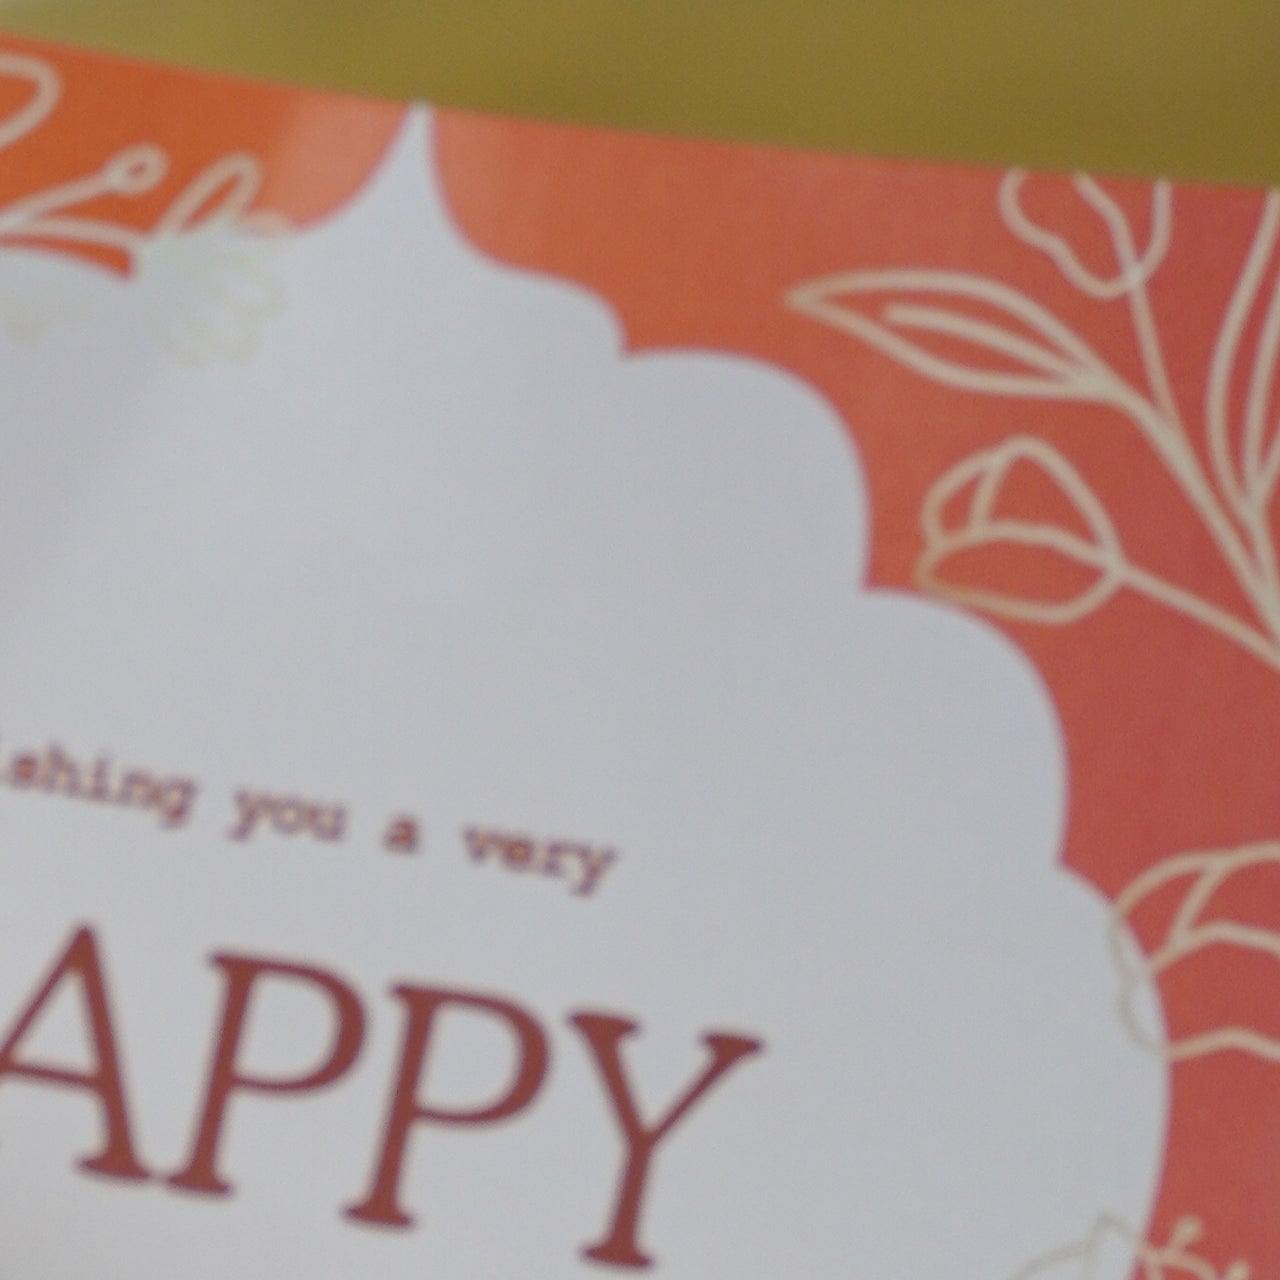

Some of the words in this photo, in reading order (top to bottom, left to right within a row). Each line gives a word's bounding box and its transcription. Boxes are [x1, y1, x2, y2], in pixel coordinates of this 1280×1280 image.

[231, 791, 346, 841] you
[385, 814, 421, 855] a
[463, 828, 616, 896] very
